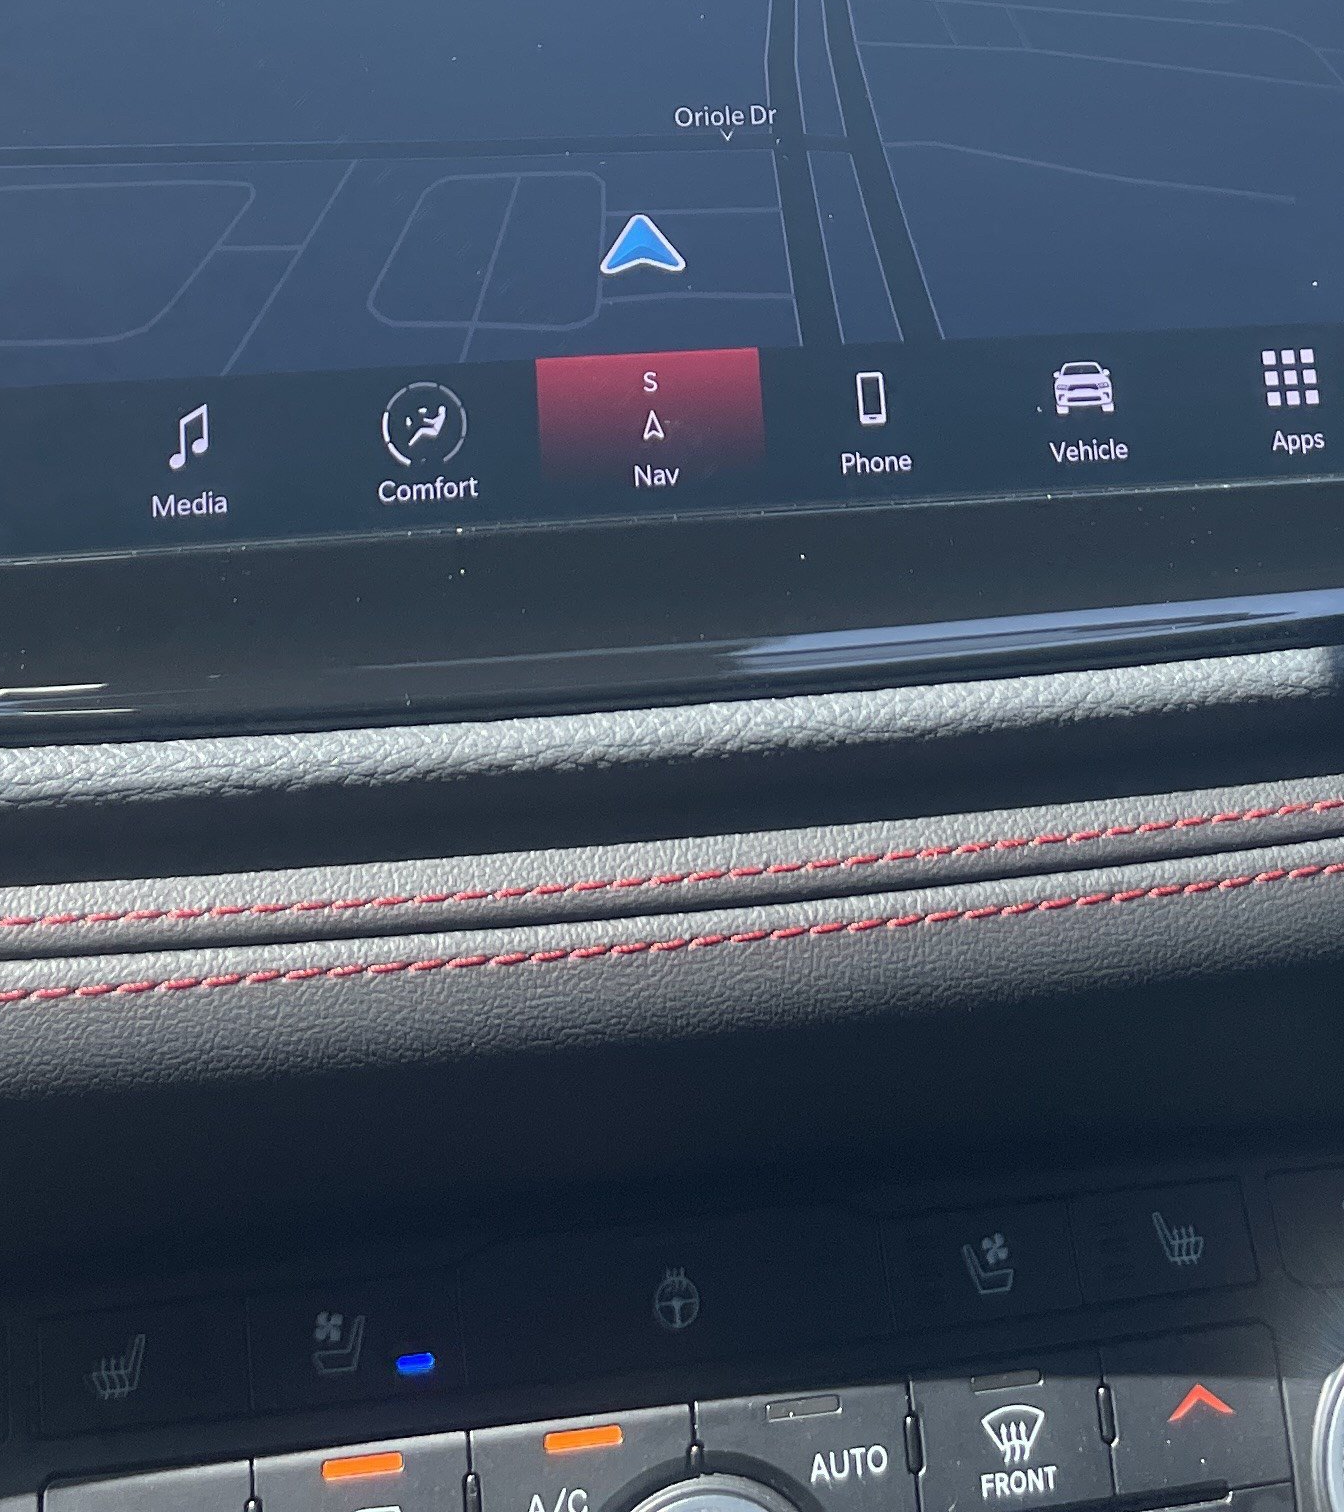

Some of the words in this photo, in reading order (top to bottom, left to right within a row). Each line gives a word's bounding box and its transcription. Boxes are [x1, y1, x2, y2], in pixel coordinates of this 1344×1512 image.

[674, 105, 746, 128] Oriole
[750, 104, 777, 126] Dr
[642, 371, 659, 393] S
[1049, 437, 1130, 464] Vehicle
[1272, 429, 1326, 454] Apps
[634, 463, 681, 487] Nav
[841, 450, 913, 475] Phone
[378, 475, 480, 504] Comfort
[152, 491, 229, 519] Media
[810, 1444, 889, 1484] AUTO
[979, 1464, 1058, 1500] FRONT
[527, 1487, 590, 1512] A/C
